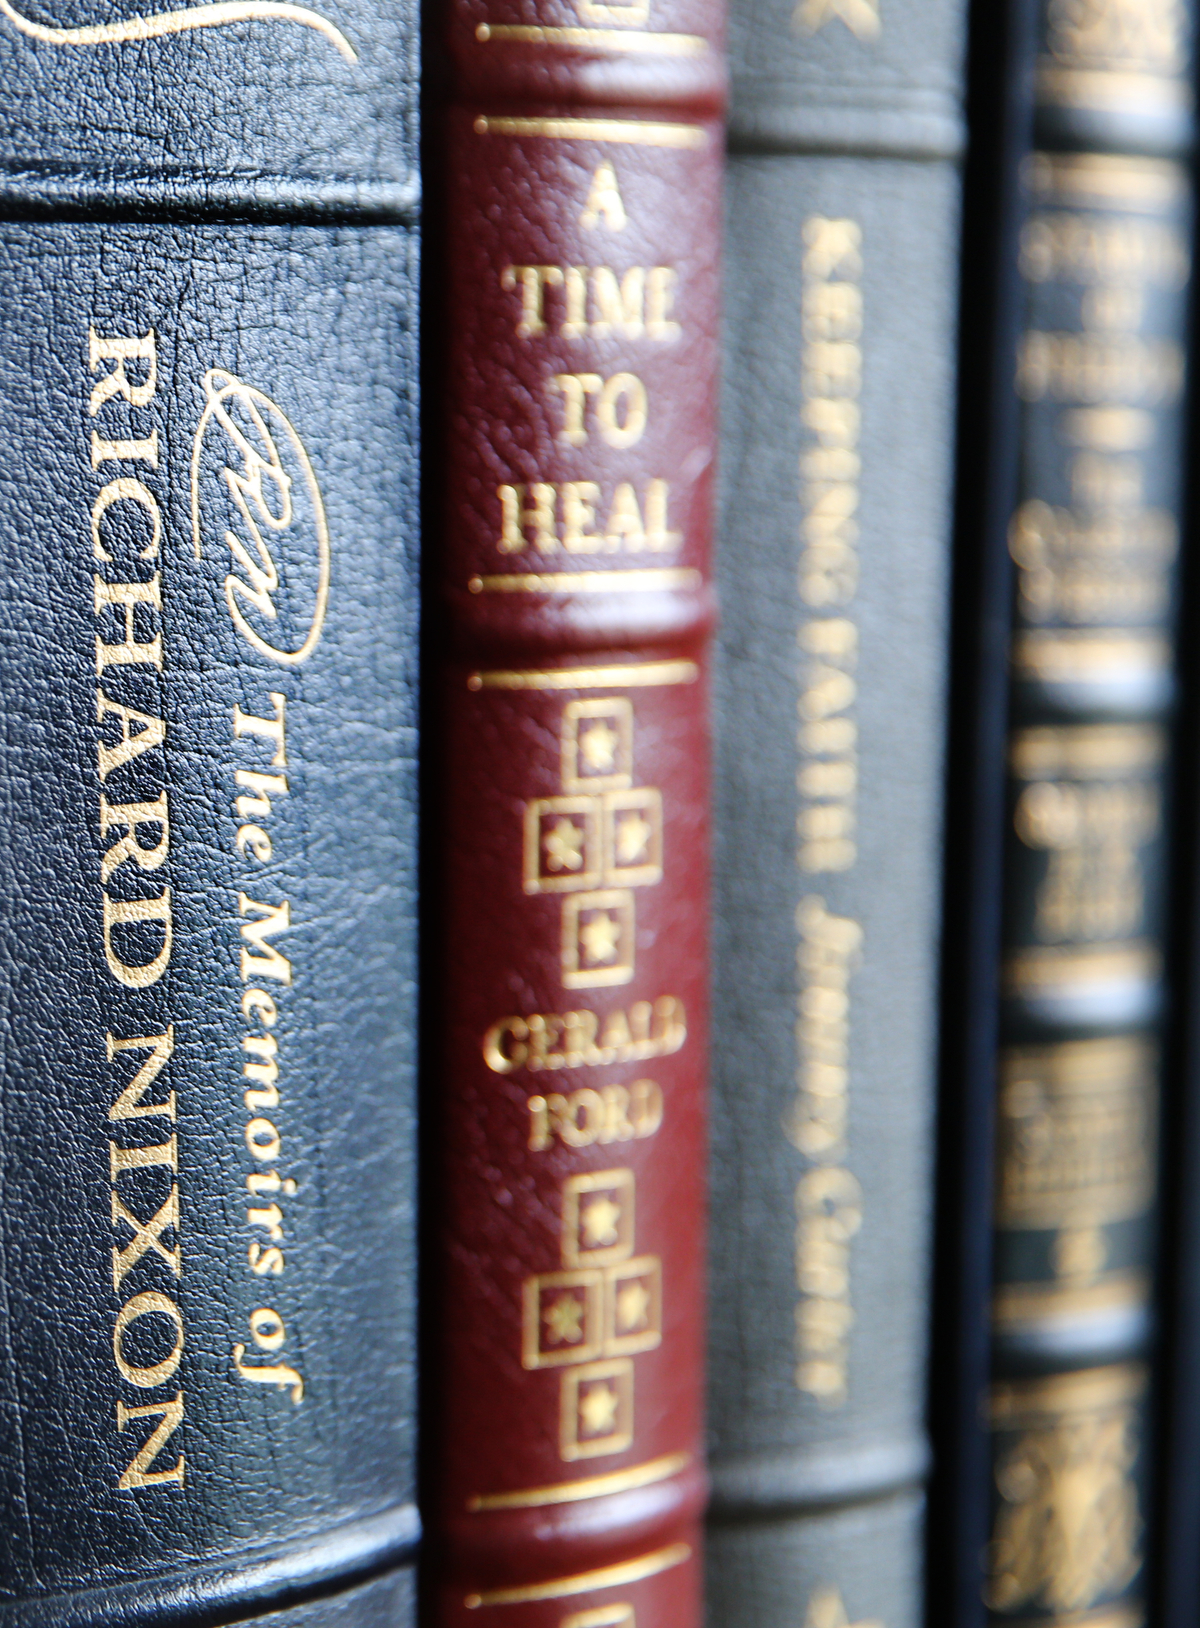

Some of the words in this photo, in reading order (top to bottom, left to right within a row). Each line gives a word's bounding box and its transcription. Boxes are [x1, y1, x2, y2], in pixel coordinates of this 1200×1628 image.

[578, 160, 627, 233] A
[503, 263, 682, 343] TIME
[552, 372, 648, 450] TO
[497, 478, 683, 556] HEAL
[88, 327, 174, 989] RICHARD
[233, 692, 290, 862] The
[483, 994, 688, 1075] GERALD
[238, 891, 298, 1277] Memoirs
[527, 1078, 664, 1152] FORD
[105, 1024, 186, 1492] NIXON
[233, 1307, 304, 1405] of
